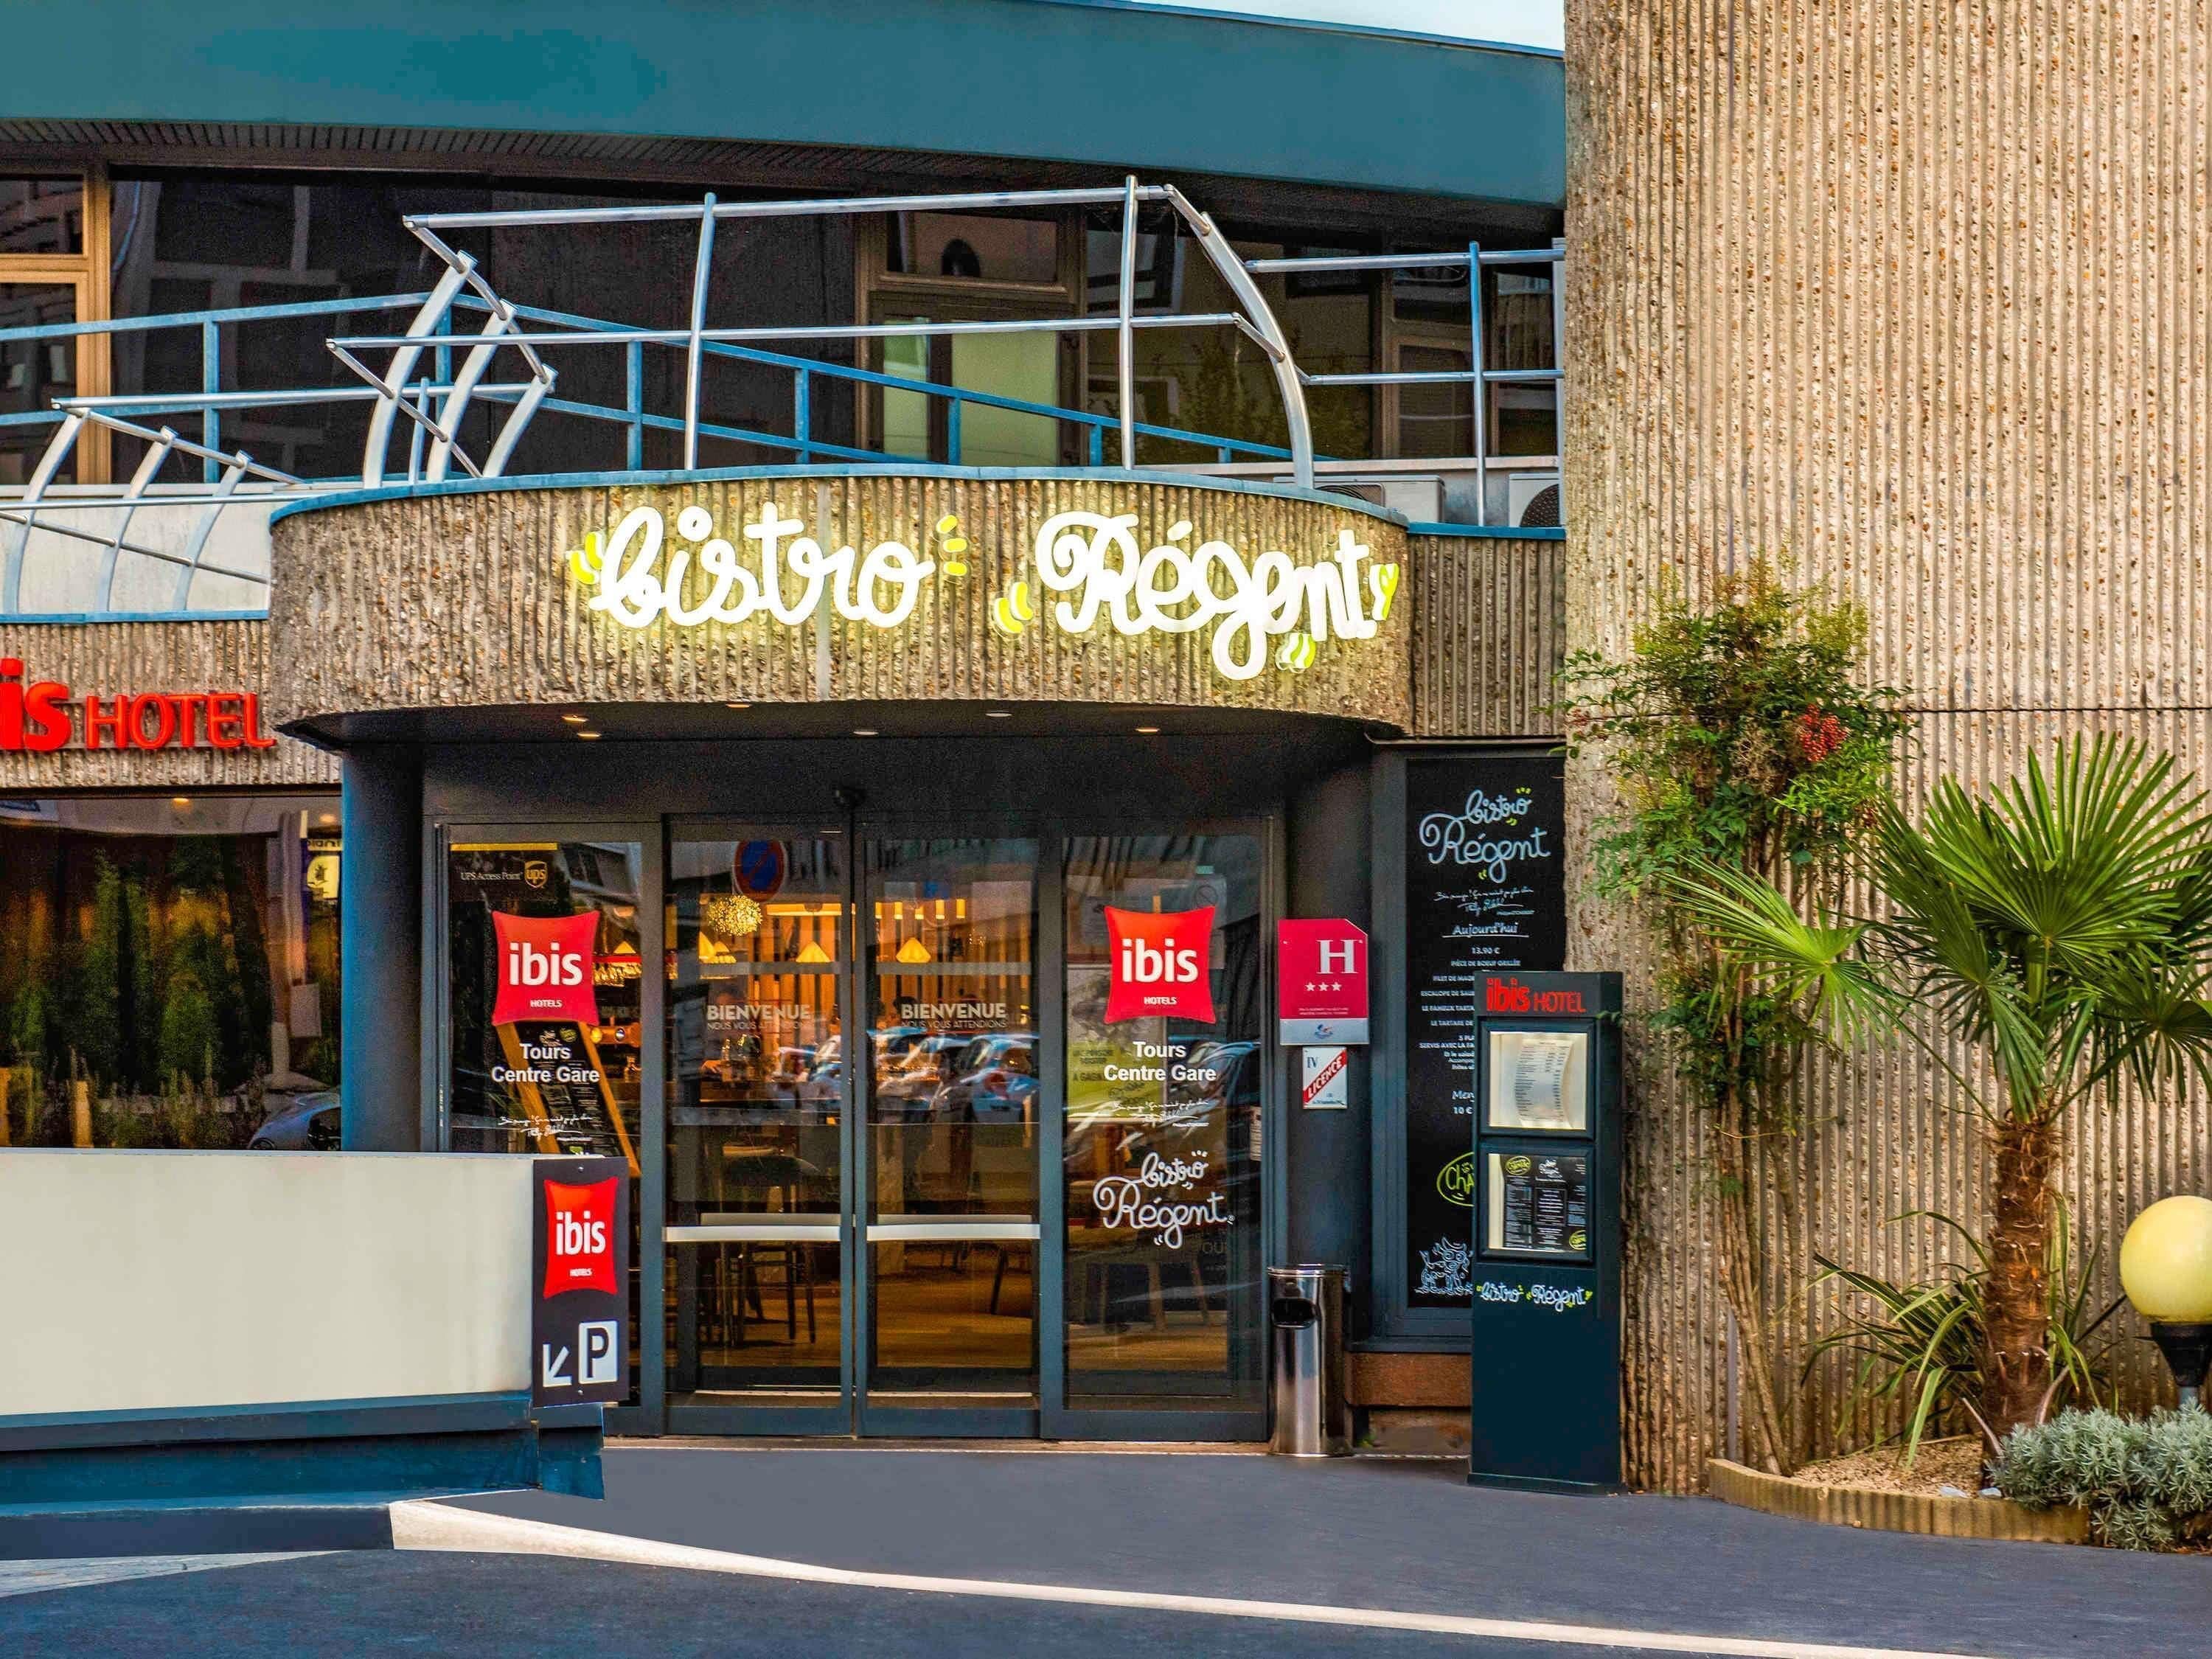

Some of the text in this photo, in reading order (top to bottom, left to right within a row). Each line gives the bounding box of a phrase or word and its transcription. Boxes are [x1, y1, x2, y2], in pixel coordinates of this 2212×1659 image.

[588, 502, 1379, 681] bistro Régent
[86, 692, 277, 750] HOTEL
[1465, 789, 1532, 824] bistro
[1419, 813, 1551, 883] Régent
[1452, 922, 1518, 938] Aujourd'hui
[508, 942, 583, 987] ibis
[1121, 938, 1199, 983] ibis
[1316, 939, 1358, 974] H
[529, 999, 563, 1008] HOTELS
[707, 1004, 812, 1020] BIENVENUE
[901, 1003, 1007, 1019] BIENVENUE
[1144, 997, 1178, 1005] HOTELS
[1486, 977, 1587, 1013] ibis HOTEL
[518, 1043, 571, 1060] Tours
[1133, 1041, 1186, 1058] Tours
[1307, 1056, 1319, 1068] IV
[491, 1065, 600, 1083] Centre Gare
[1104, 1064, 1217, 1082] Centre Gare
[1307, 1055, 1343, 1099] LICENCE
[1141, 1152, 1209, 1188] bistro
[1093, 1175, 1228, 1249] Régent
[555, 1210, 606, 1255] ibis
[1481, 1281, 1587, 1312] bistro Régent
[586, 1327, 610, 1378] P
